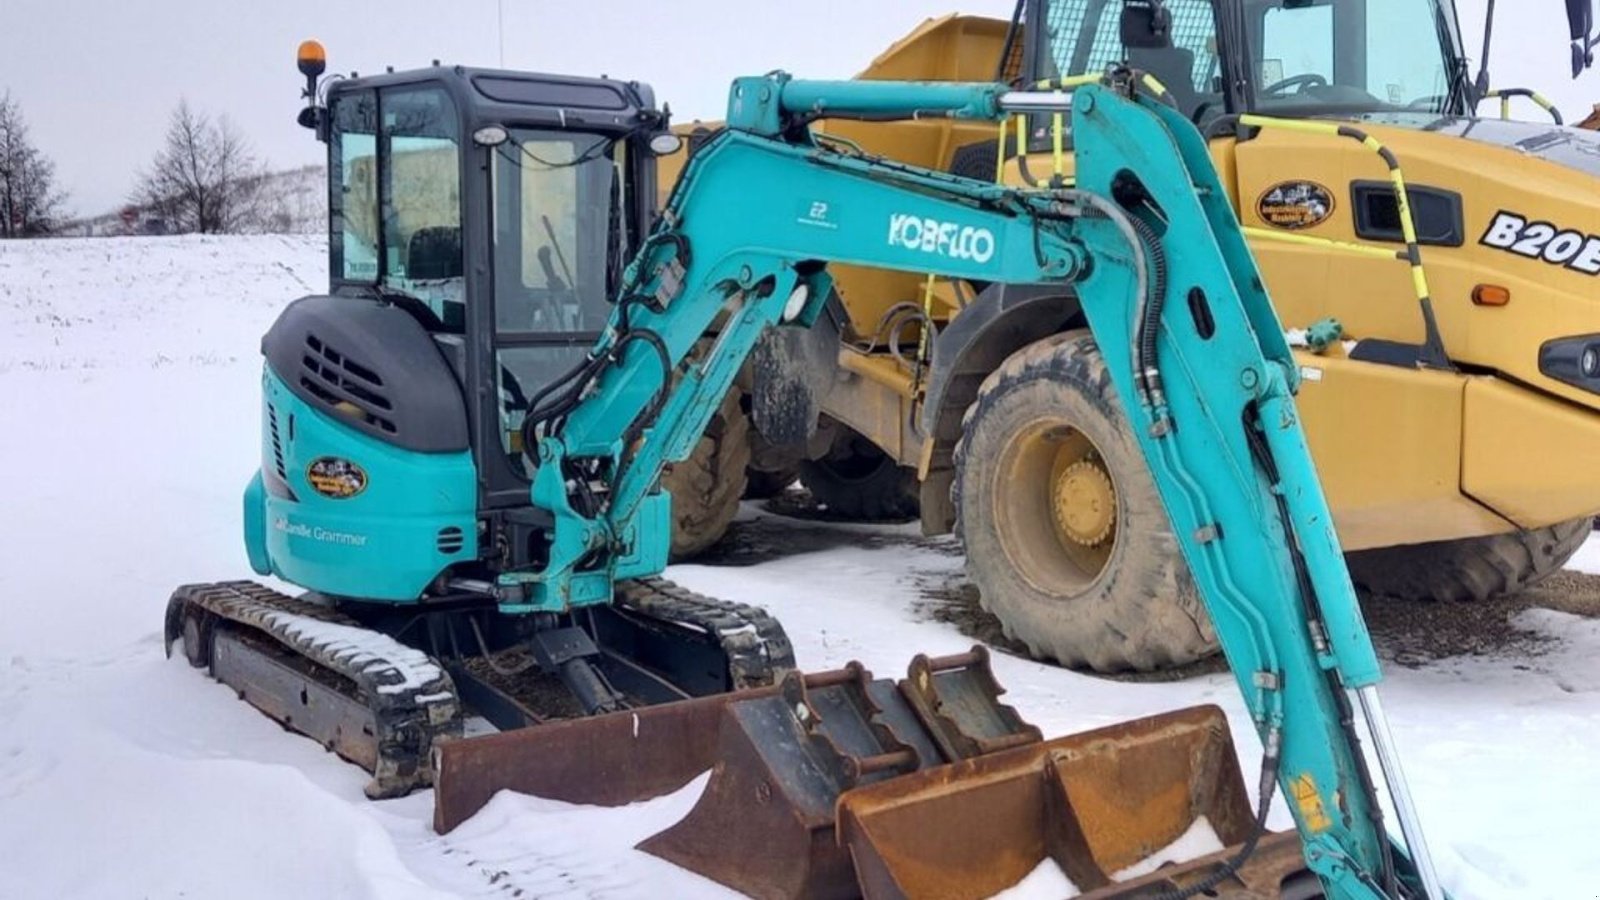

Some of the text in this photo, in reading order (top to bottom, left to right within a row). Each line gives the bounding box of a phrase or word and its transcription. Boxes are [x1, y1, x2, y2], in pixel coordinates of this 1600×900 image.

[888, 213, 995, 264] KOBELCO
[1479, 210, 1600, 275] B20E
[313, 527, 367, 546] Grammer
